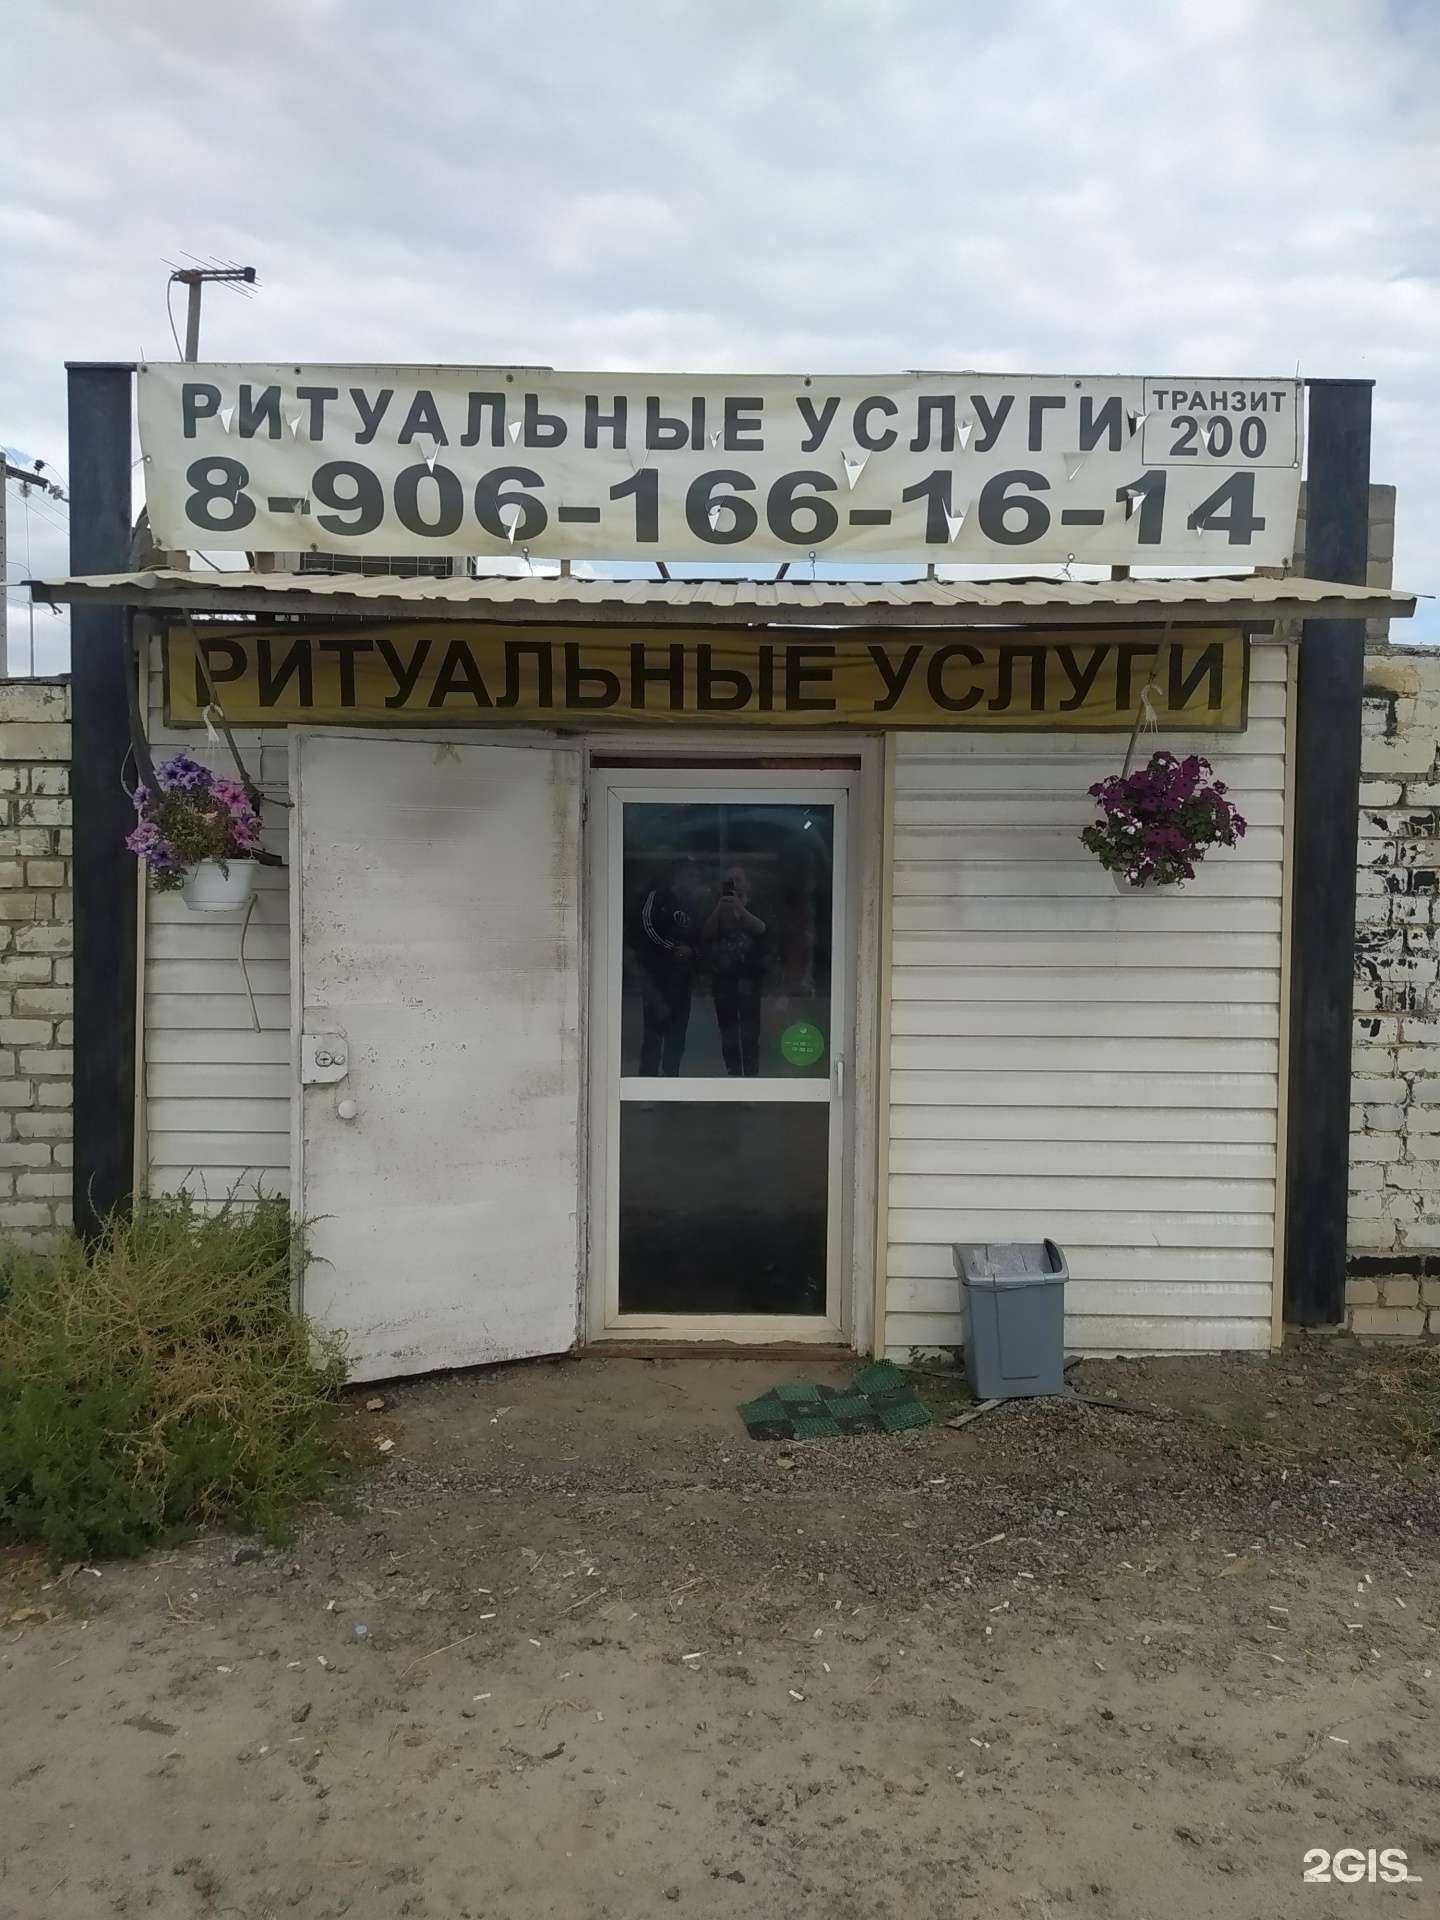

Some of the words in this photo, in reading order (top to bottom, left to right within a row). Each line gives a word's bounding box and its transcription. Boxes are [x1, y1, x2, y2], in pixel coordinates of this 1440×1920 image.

[181, 382, 765, 453] РИТУАЛЬНЫЕ
[795, 394, 1123, 453] УСЛУГИ
[1152, 388, 1287, 413] ТРАНЗИТ
[1168, 413, 1267, 459] 200
[183, 455, 1266, 546] 8-906-166-16-14
[195, 638, 836, 711] РИТУАЛЬНЫЕ
[866, 642, 1225, 712] УСЛУГИ
